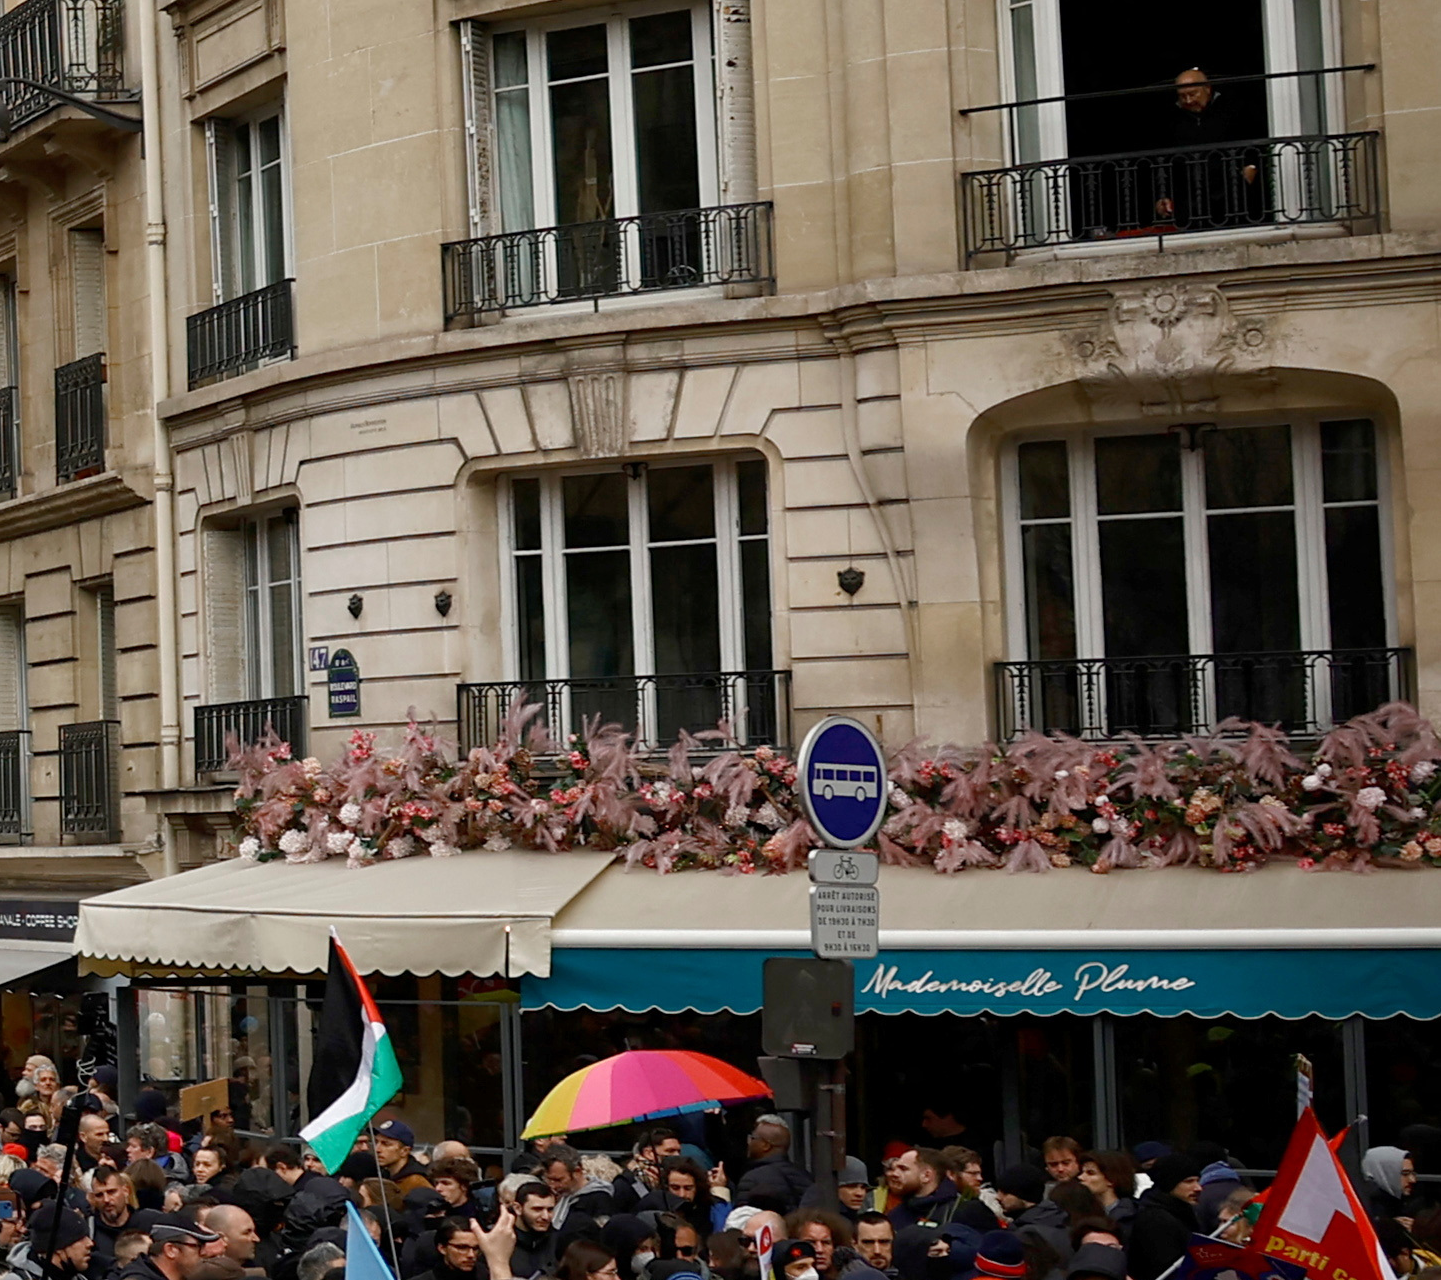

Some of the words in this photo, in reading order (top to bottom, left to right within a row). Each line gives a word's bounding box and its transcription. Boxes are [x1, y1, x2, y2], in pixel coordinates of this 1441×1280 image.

[310, 648, 327, 669] 147
[331, 695, 357, 704] RASPAIL
[818, 891, 840, 900] ARRÊT
[817, 904, 834, 913] POUR
[836, 905, 876, 914] LIVRAISONS
[818, 917, 826, 926] DE
[847, 931, 856, 939] DE
[861, 962, 1063, 999] Mademoiselle
[1074, 961, 1196, 1002] Plume
[1264, 1235, 1331, 1271] Parti
